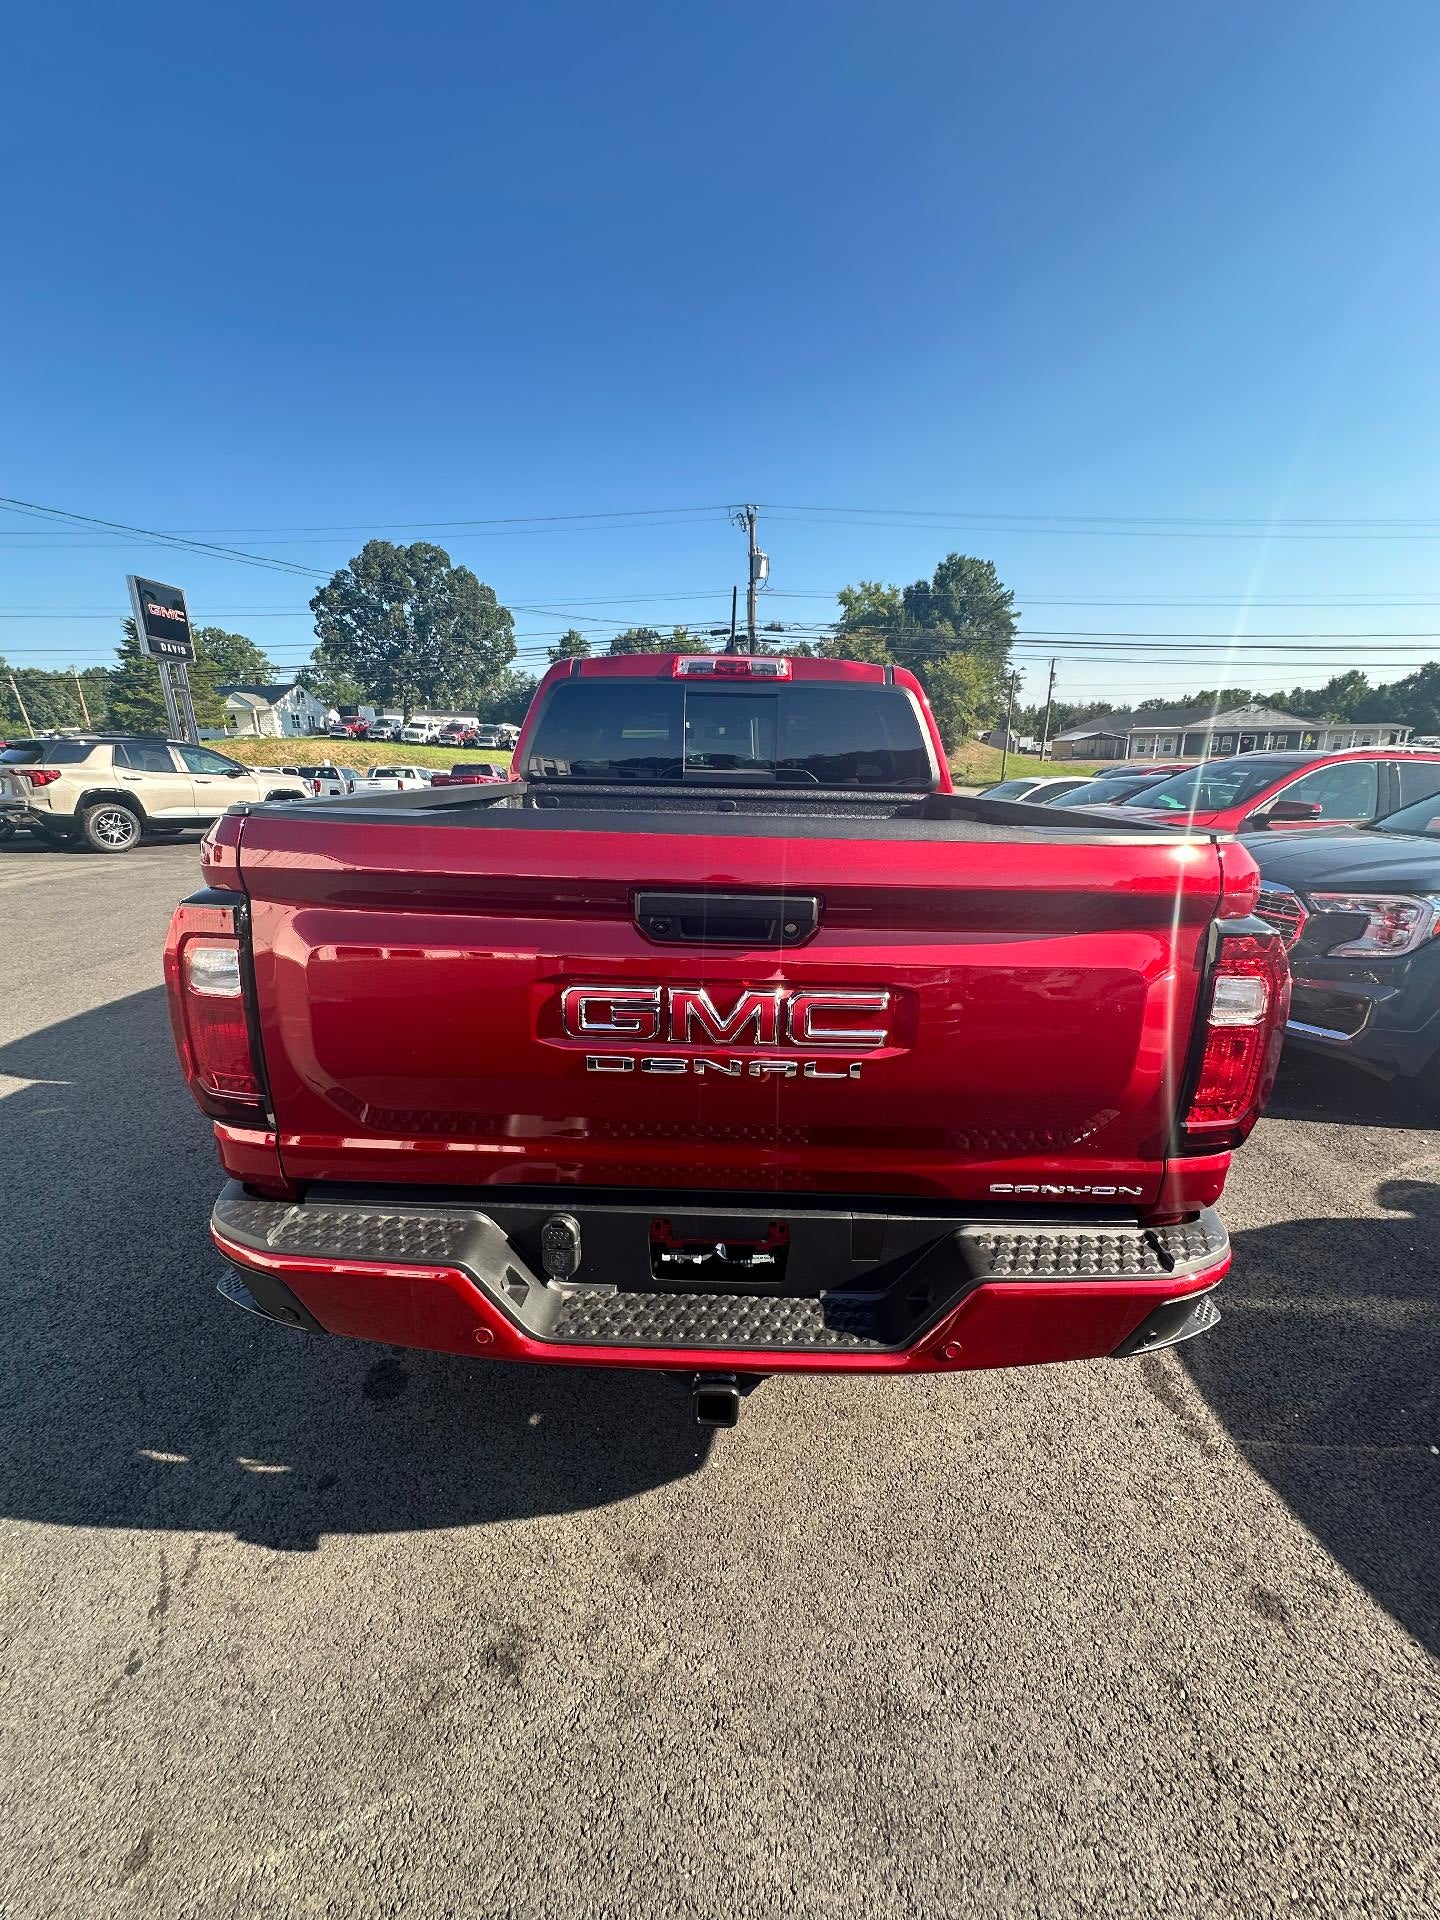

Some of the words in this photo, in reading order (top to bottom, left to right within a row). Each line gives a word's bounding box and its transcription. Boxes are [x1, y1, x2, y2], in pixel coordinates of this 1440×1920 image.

[148, 603, 186, 622] GMC
[160, 642, 187, 655] DAVIS
[561, 985, 890, 1047] GMC
[586, 1055, 863, 1079] DENALI
[989, 1183, 1143, 1196] CANYON
